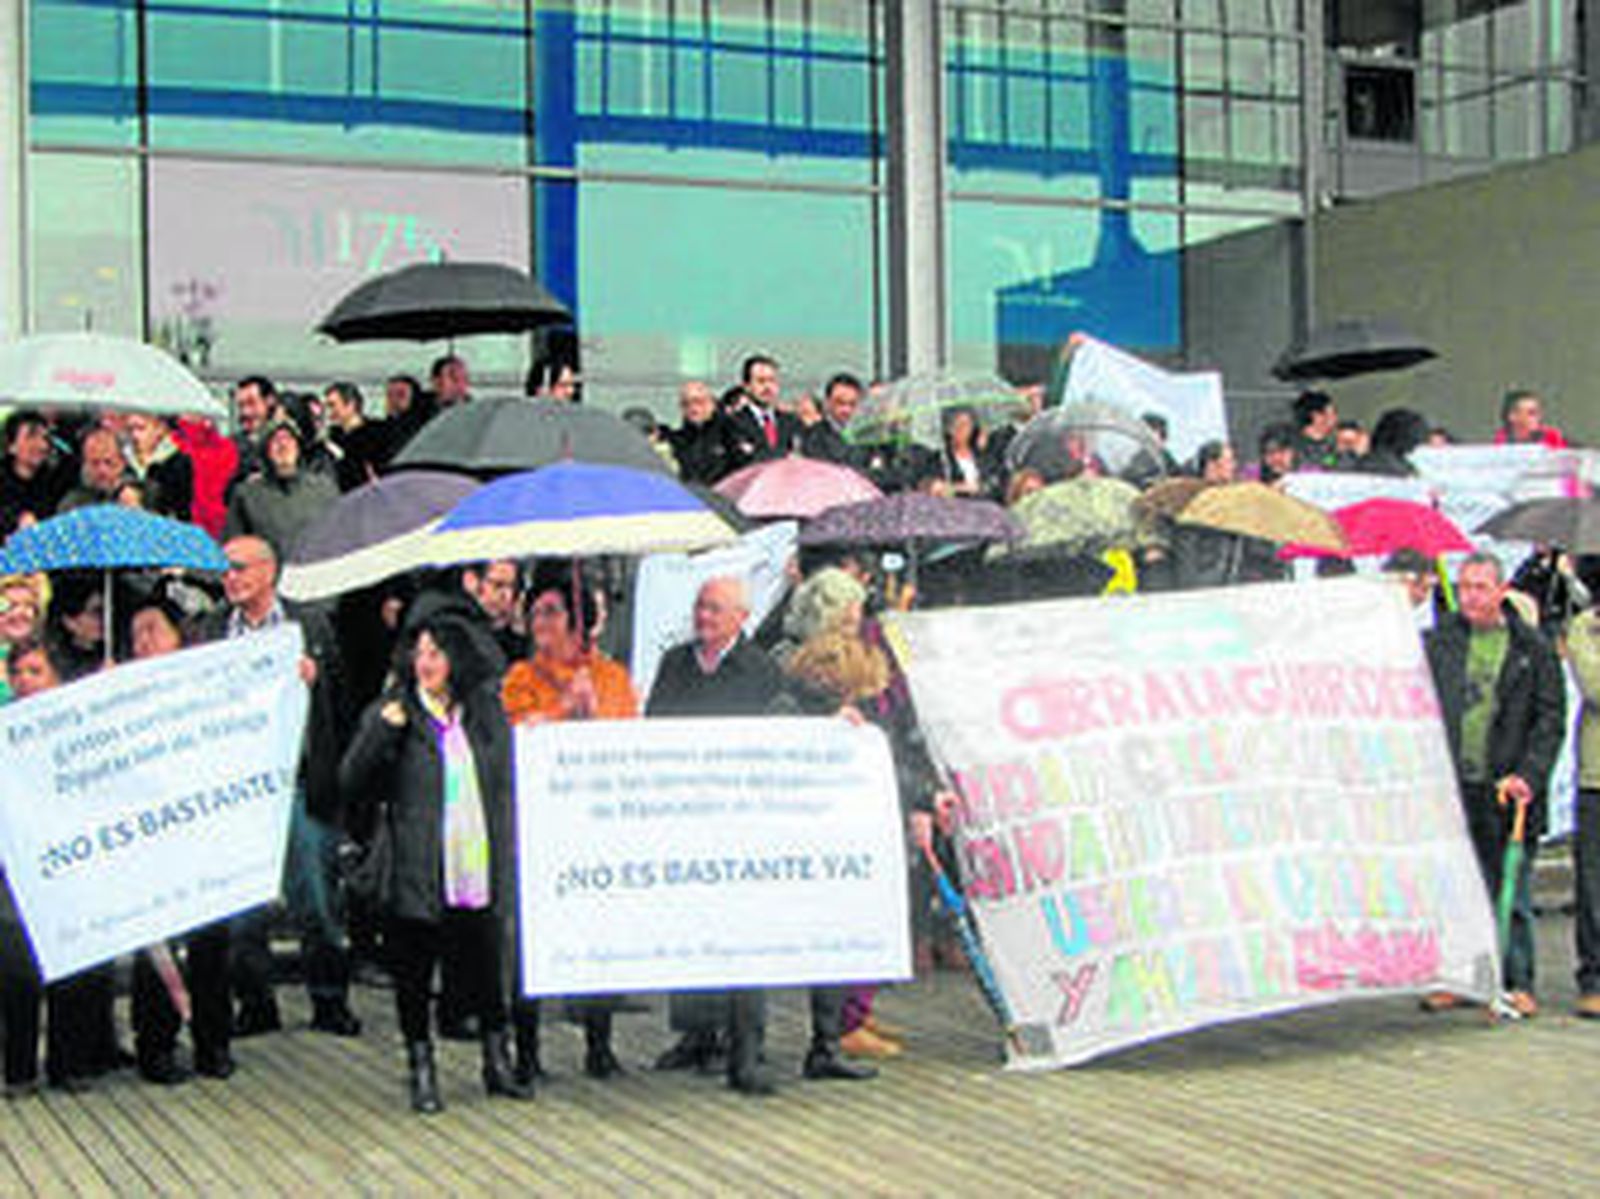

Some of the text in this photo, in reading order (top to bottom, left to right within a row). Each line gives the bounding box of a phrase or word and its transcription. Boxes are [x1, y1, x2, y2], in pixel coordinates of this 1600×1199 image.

[98, 820, 135, 851] ES
[138, 771, 279, 837] BASTANTE
[620, 860, 656, 888] ES
[662, 855, 814, 886] BASTANTE
